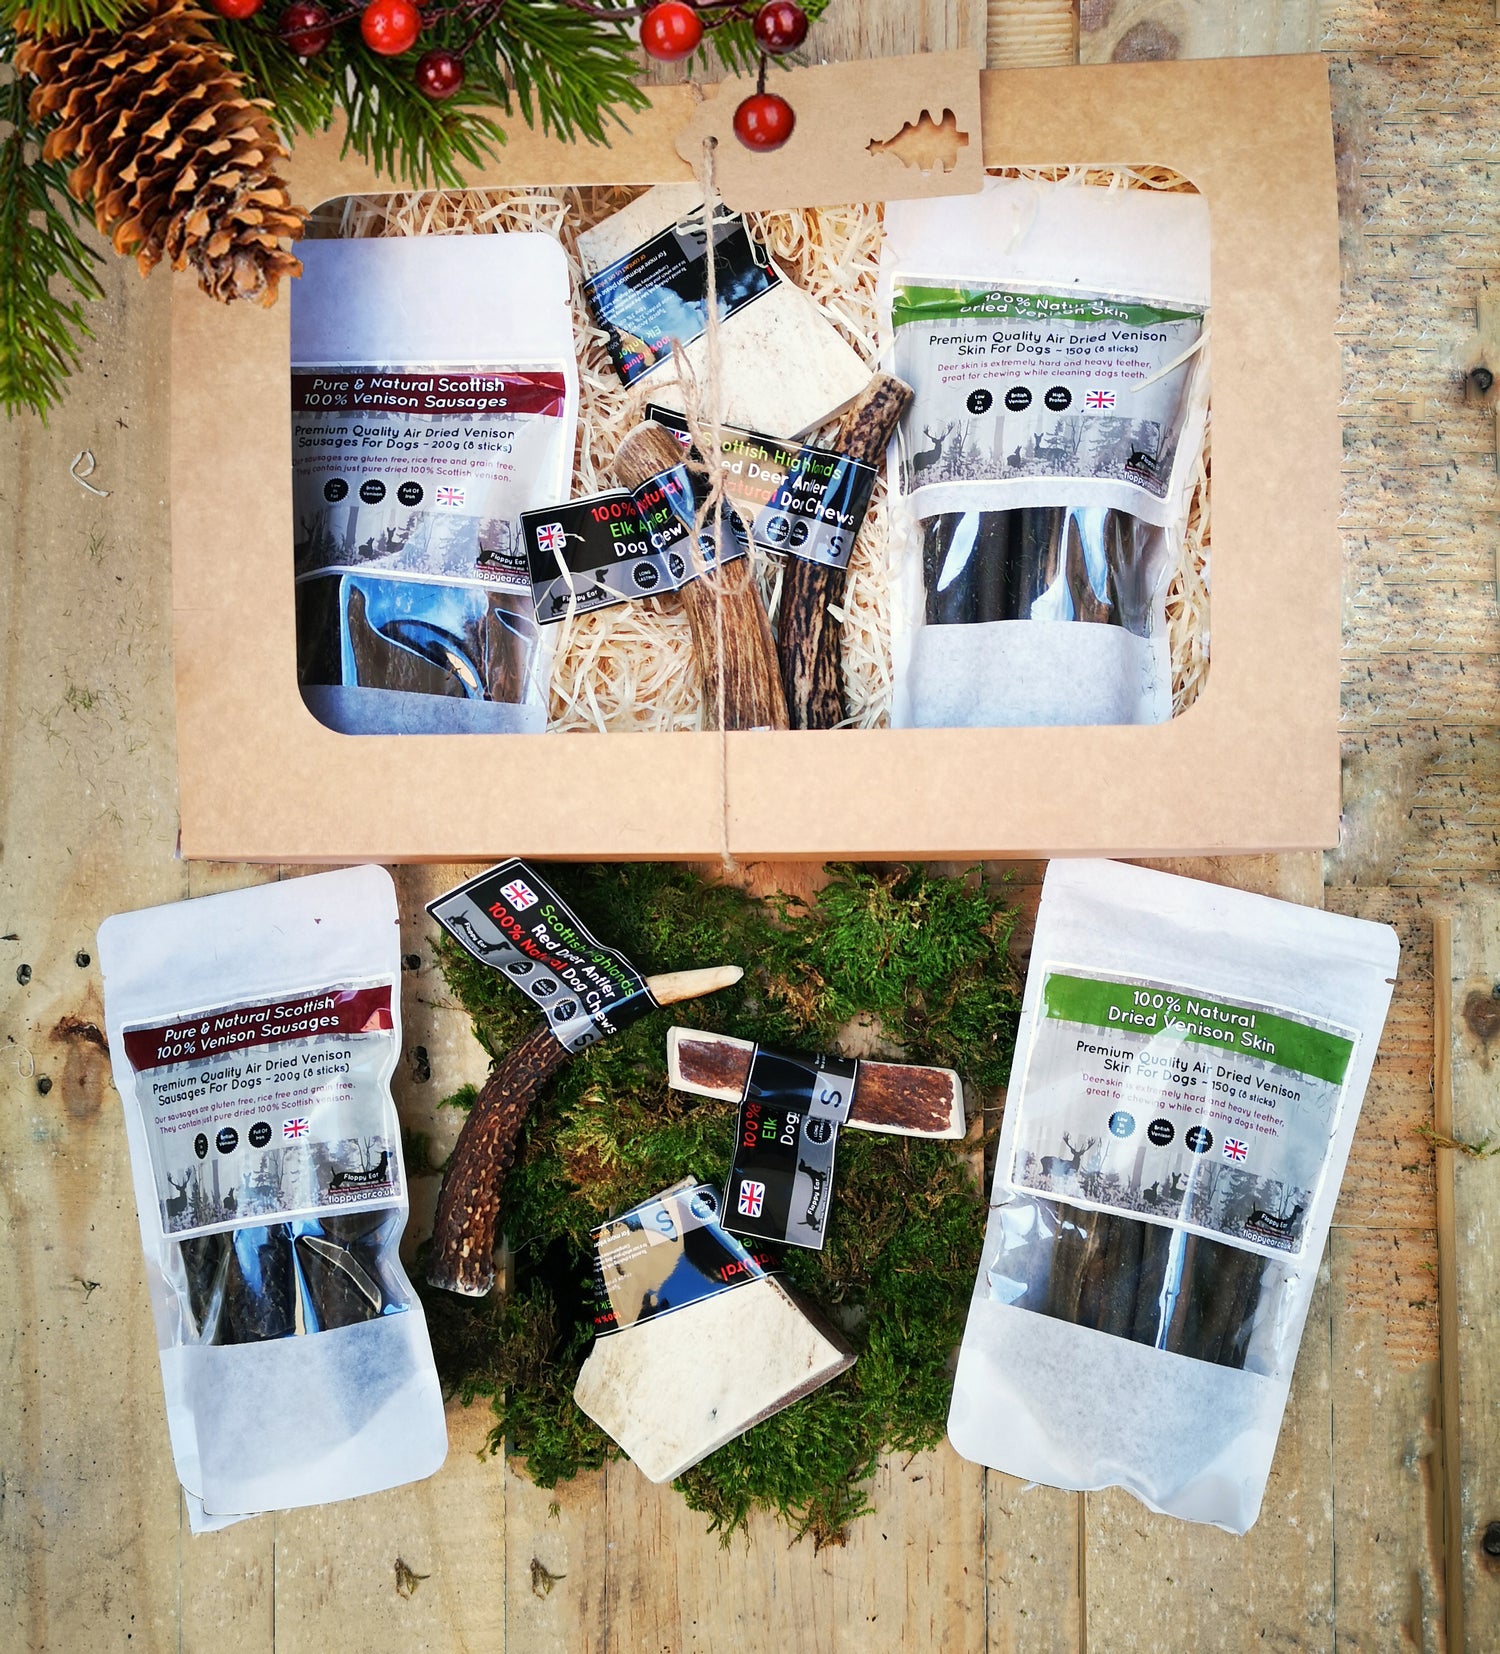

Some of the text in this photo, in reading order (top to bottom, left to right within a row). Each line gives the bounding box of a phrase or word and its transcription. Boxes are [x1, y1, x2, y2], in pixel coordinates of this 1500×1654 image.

[617, 266, 645, 286] information
[986, 292, 1030, 306] 100%
[1092, 306, 1128, 319] Skin
[646, 325, 661, 338] Elk
[930, 330, 1167, 345] Premium Quality Air Dried Venison
[958, 346, 985, 355] Skin
[991, 344, 1012, 353] For
[1017, 343, 1050, 355] Dogs
[1066, 346, 1090, 355] 150g
[1108, 345, 1138, 353] sticks)
[1116, 360, 1151, 369] teether,
[313, 378, 504, 392] Pure & Natural Scottish
[942, 374, 965, 383] great
[983, 370, 1020, 378] chewing
[1095, 370, 1118, 378] dogs
[1121, 370, 1147, 378] teeth.
[304, 392, 507, 409] 100% Venison Sausages
[295, 425, 514, 439] Premium Quality Air Dried Venison
[299, 437, 512, 453] Sausages For Dogs 200g (8 sticks)
[437, 468, 471, 476] Scottish
[748, 464, 789, 486] Deer
[591, 502, 636, 522] 100%
[805, 499, 854, 526] Chews
[610, 522, 634, 538] Elk
[614, 541, 648, 557] Dog
[827, 536, 843, 557] S
[490, 553, 512, 564] Floppy
[540, 904, 587, 952] Scottish
[488, 902, 525, 940] 100%
[562, 968, 587, 992] Dog
[586, 991, 617, 1034] Chews
[531, 923, 560, 950] Red
[582, 966, 615, 998] Antler
[165, 997, 334, 1042] Pure & Natural Scottish
[1134, 991, 1255, 1028] 100% Natural
[157, 1015, 339, 1059] 100% Venison Sausages
[574, 1033, 593, 1047] S
[1108, 1006, 1275, 1054] Dried Venison Skin
[153, 1050, 351, 1094] Premium Quality Air Dried Venison
[1077, 1041, 1300, 1101] Premium Quality Air Dried Venison
[159, 1063, 349, 1106] Sausages For Dogs 200g (8 sticks)
[1104, 1059, 1131, 1073] Skin
[1137, 1065, 1158, 1078] For
[1162, 1070, 1197, 1086] Dogs
[1212, 1081, 1236, 1096] 150g
[1249, 1094, 1276, 1108] sticks)
[168, 1108, 199, 1121] sausages
[211, 1100, 235, 1111] gluten
[293, 1088, 308, 1096] and
[820, 1089, 842, 1108] S
[1082, 1073, 1104, 1083] Deer
[1106, 1078, 1122, 1087] skin
[1184, 1092, 1206, 1102] hard
[1228, 1103, 1251, 1117] heavy
[1254, 1110, 1284, 1127] teether,
[160, 1125, 176, 1134] They
[214, 1113, 232, 1122] pure
[234, 1107, 255, 1117] dried
[258, 1105, 279, 1113] 100%
[282, 1098, 313, 1109] Scottish
[1086, 1088, 1279, 1137] great while dogs teeth.
[762, 1117, 777, 1139] Elk
[329, 1188, 395, 1203] floppyear.co.uk
[808, 1192, 819, 1215] Floppy
[656, 1210, 673, 1231] S
